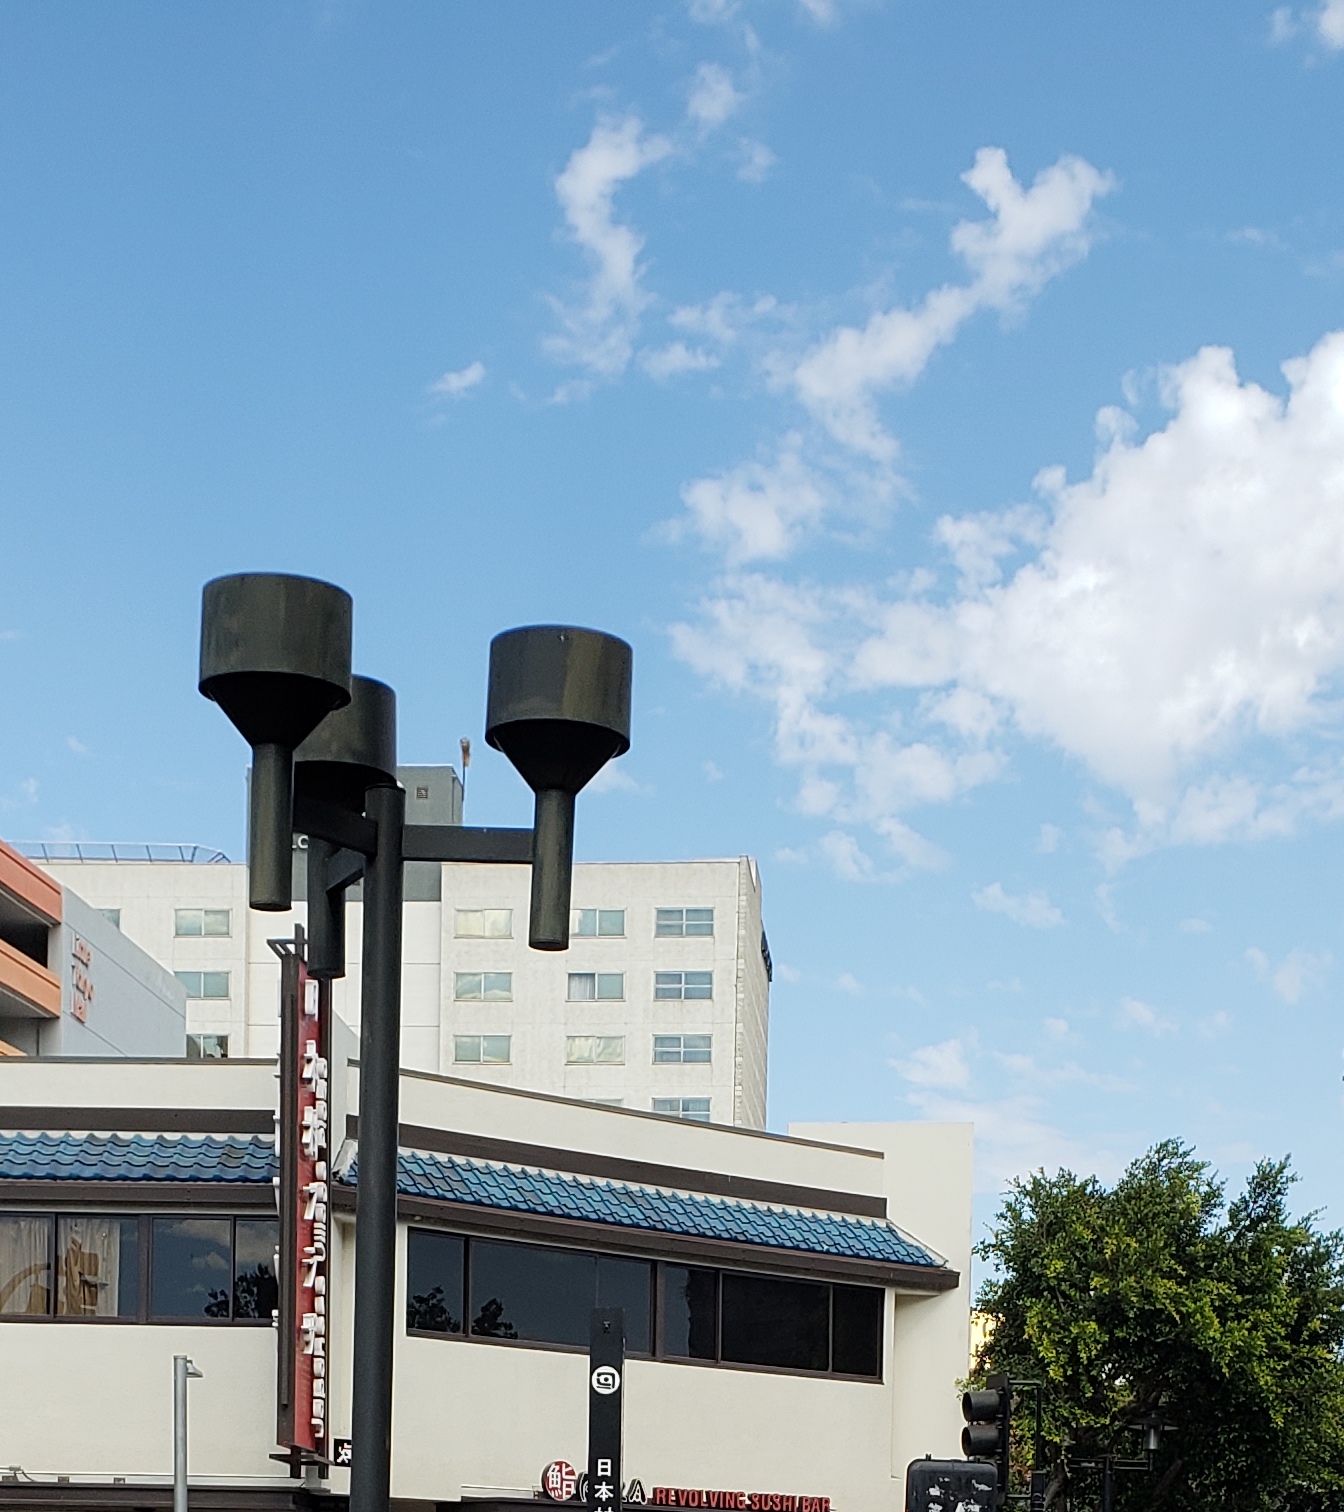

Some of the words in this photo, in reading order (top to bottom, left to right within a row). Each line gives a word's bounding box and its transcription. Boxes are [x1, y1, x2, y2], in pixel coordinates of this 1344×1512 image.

[546, 1461, 577, 1501] 鮨
[654, 1486, 746, 1510] REVOLVING
[751, 1493, 798, 1512] SUSHI
